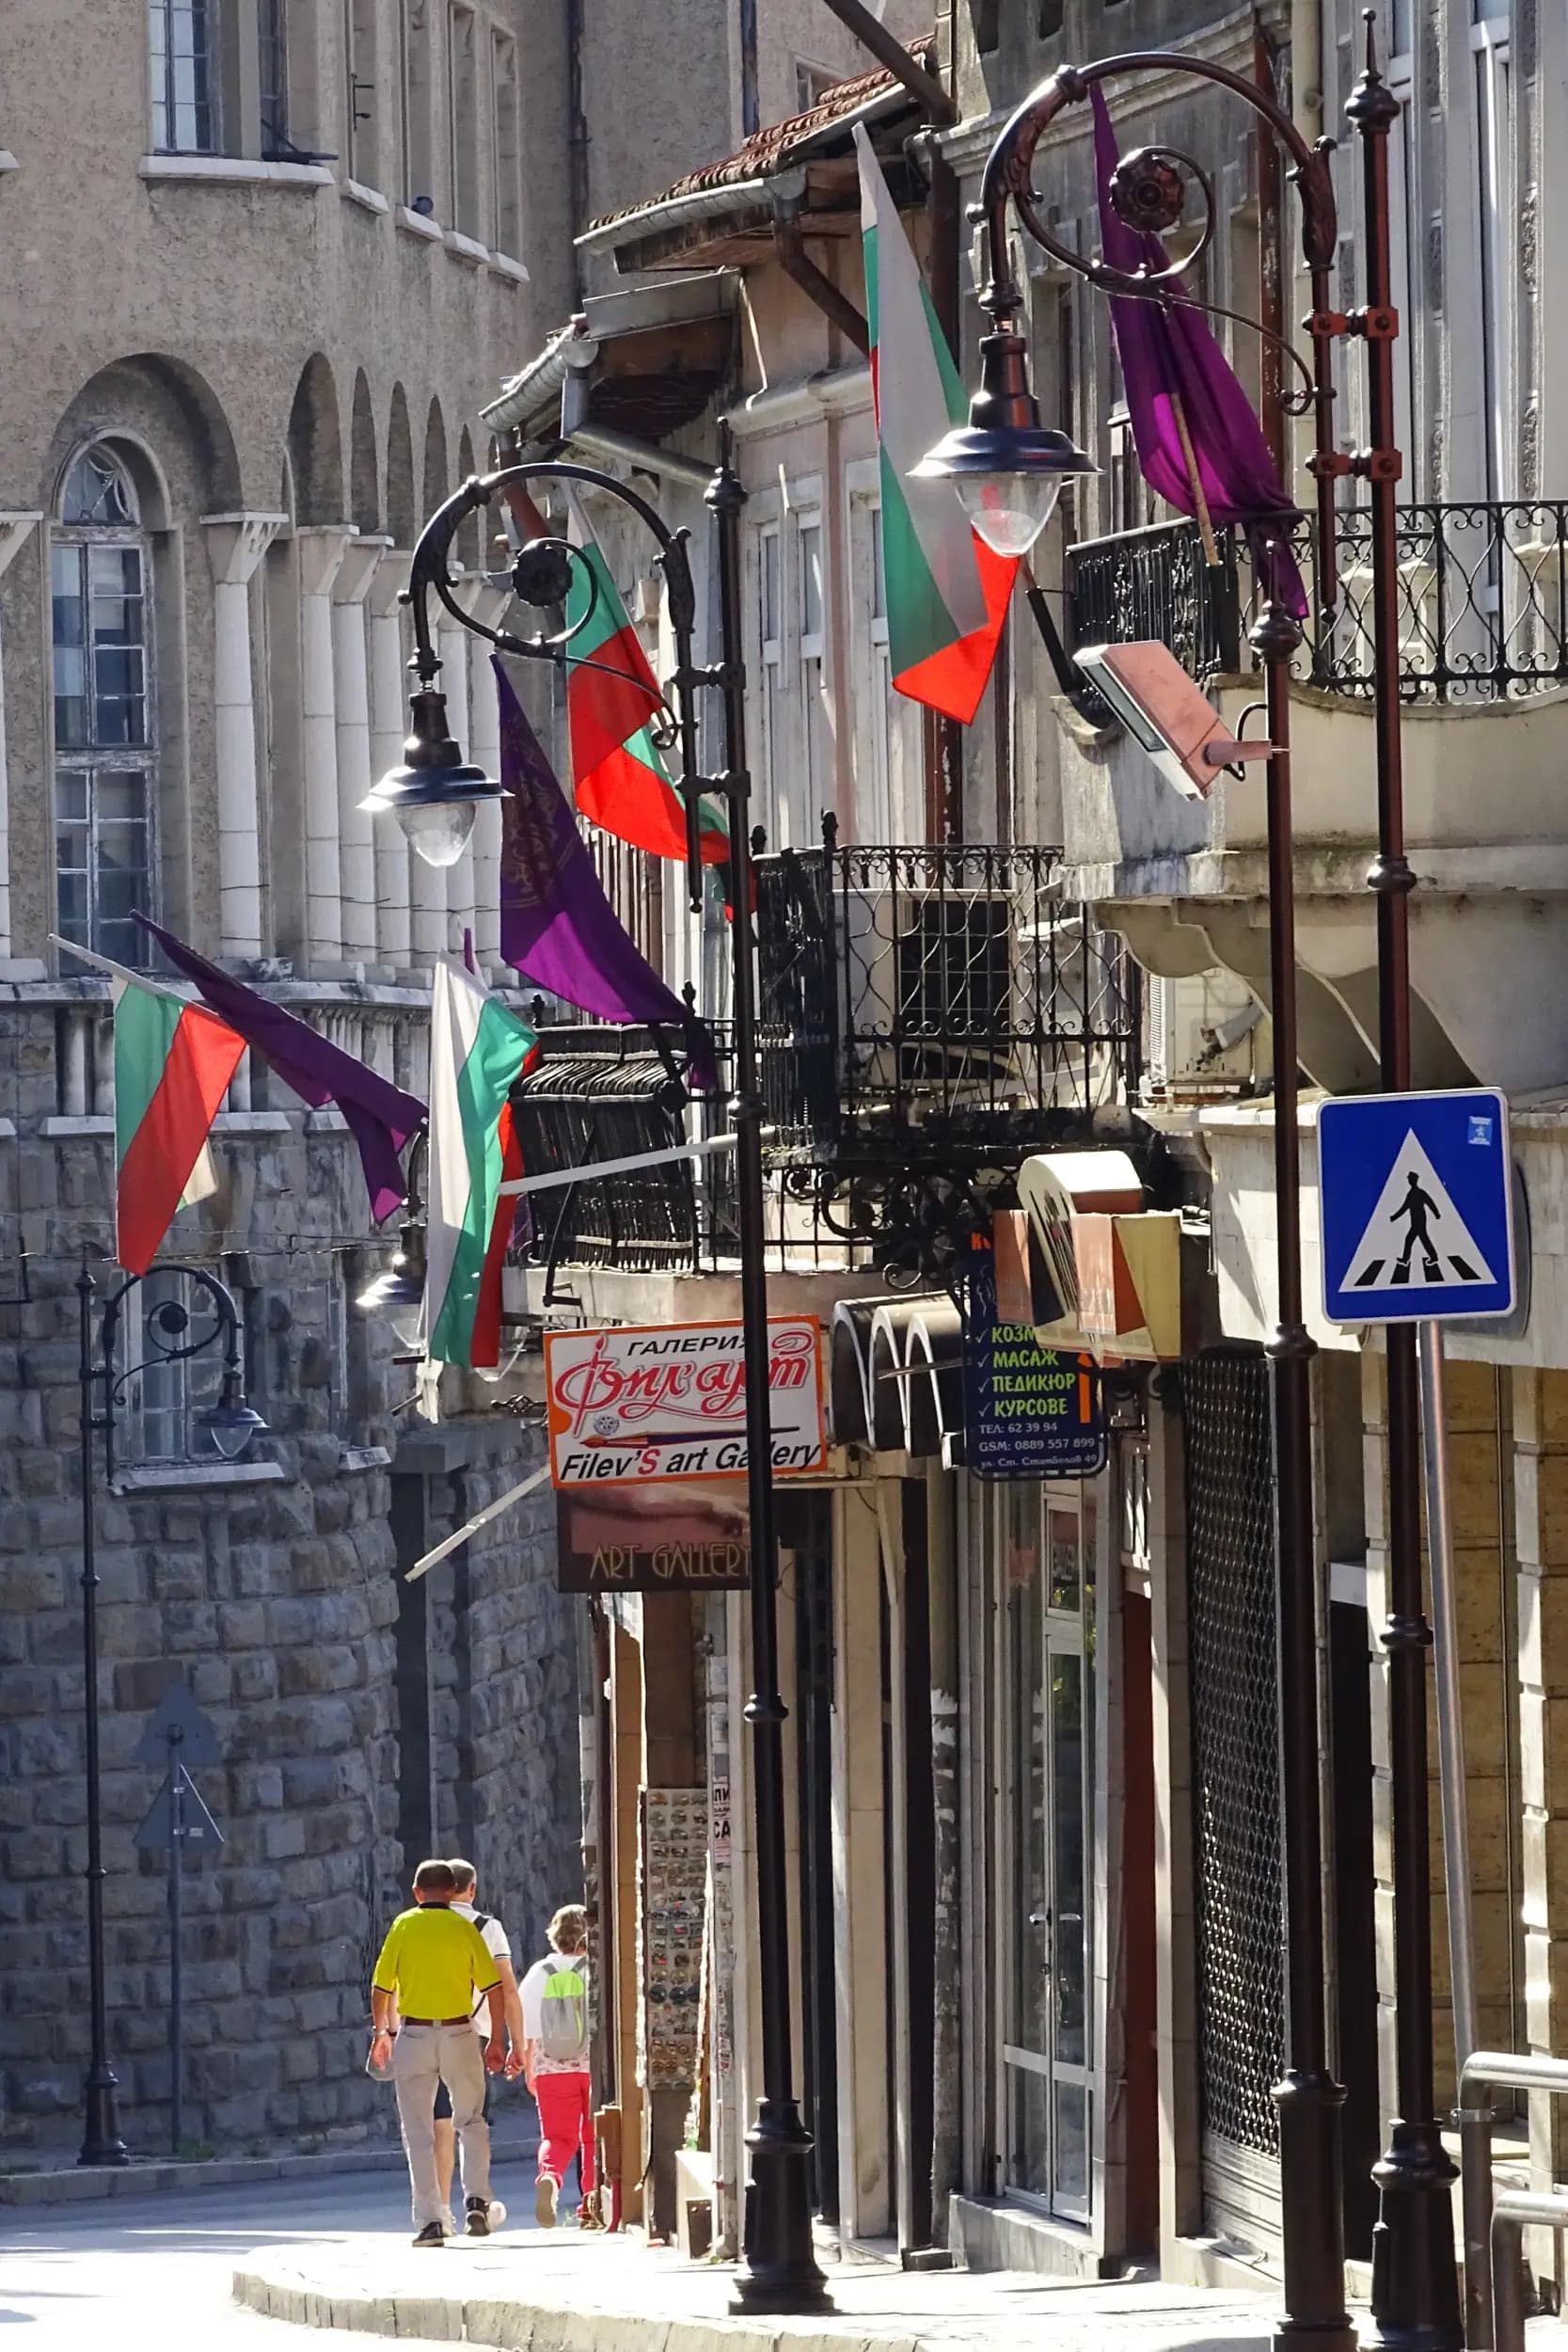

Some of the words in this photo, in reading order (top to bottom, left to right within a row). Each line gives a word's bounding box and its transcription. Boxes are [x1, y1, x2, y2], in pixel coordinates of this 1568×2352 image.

[627, 1335, 747, 1357] ГАЛЕРИ
[993, 1349, 1059, 1368] МАСАЖ
[992, 1373, 1076, 1392] ПЕДИКЮР
[994, 1398, 1069, 1418] КУРСОВЕ
[979, 1423, 1005, 1434] ТЕЛ:
[1007, 1422, 1022, 1433] 62
[1025, 1422, 1040, 1433] 39
[979, 1440, 1011, 1452] GSM:
[1015, 1439, 1044, 1451] 0889
[1048, 1438, 1069, 1449] 557
[560, 1448, 661, 1481] Filev'S
[666, 1447, 708, 1473] art
[716, 1441, 820, 1471] Gaery
[589, 1543, 641, 1581] ART
